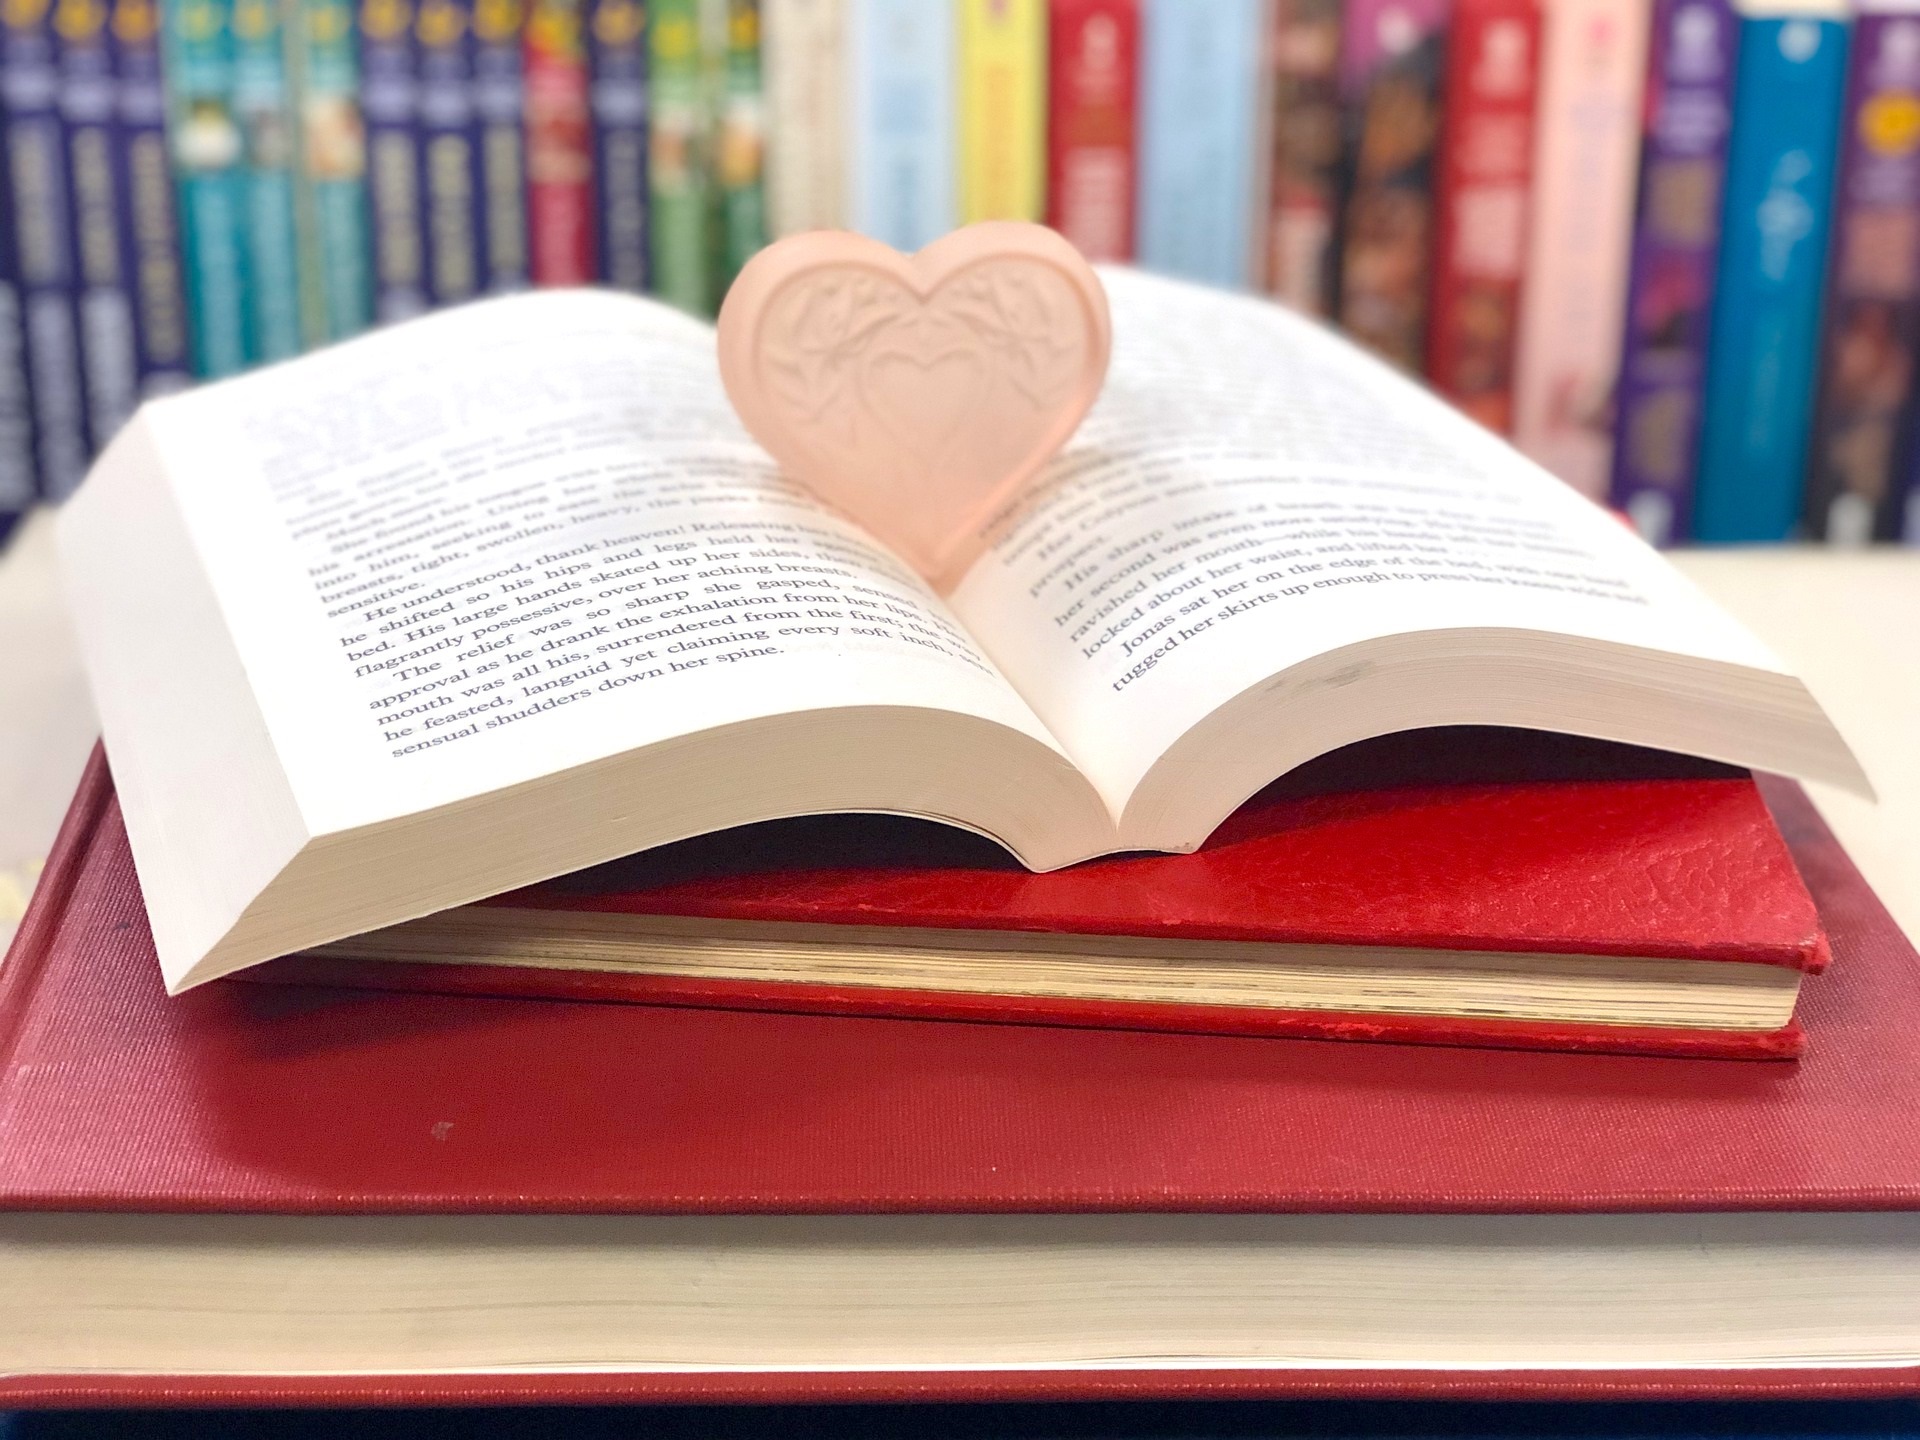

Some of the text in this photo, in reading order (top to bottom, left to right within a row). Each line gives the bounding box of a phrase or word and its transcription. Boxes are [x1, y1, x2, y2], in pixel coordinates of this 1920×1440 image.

[315, 573, 357, 590] into
[431, 521, 512, 550] seeking
[523, 511, 545, 521] to
[321, 575, 403, 603] breasts,
[411, 552, 469, 573] tight,
[476, 524, 564, 552] swollen,
[569, 506, 640, 524] heavy,
[646, 498, 682, 509] the
[328, 583, 425, 617] sensitive.
[340, 534, 800, 647] he shifted so his hips and legs held her
[364, 607, 397, 621] He
[402, 563, 531, 608] understood,
[535, 544, 599, 565] thank
[602, 525, 686, 548] heaven!
[690, 521, 796, 532] Releasing
[1054, 599, 1084, 627] her
[1090, 552, 1157, 597] second
[1161, 537, 1202, 554] was
[1206, 523, 1257, 540] even
[1064, 565, 1099, 590] His
[1106, 530, 1164, 561] sharp
[1070, 580, 1148, 642] ravished
[1151, 561, 1186, 582] her
[1082, 609, 1144, 659] locked
[1148, 577, 1204, 609] about
[1207, 563, 1242, 579] her
[1248, 549, 1312, 564] waist,
[1315, 541, 1354, 553] and
[347, 641, 395, 661] bed.
[404, 625, 445, 642] His
[452, 604, 508, 626] large
[515, 582, 582, 605] hands
[589, 561, 661, 584] skated
[668, 557, 696, 566] up
[704, 553, 739, 561] her
[749, 548, 810, 559] sides,
[354, 563, 857, 677] flagrantly possessive, over her aching breasts.
[370, 670, 470, 709] approval
[477, 662, 500, 673] as
[505, 650, 533, 663] he
[541, 626, 610, 651] drank
[616, 616, 652, 629] the
[660, 597, 778, 618] exhalation
[784, 593, 839, 602] from
[843, 595, 878, 608] her
[884, 603, 927, 623] lips.
[393, 663, 441, 681] The
[456, 634, 515, 662] relief
[529, 620, 572, 635] was
[586, 609, 610, 619] so
[625, 591, 689, 609] sharp
[704, 584, 741, 593] she
[757, 579, 840, 589] gasped,
[852, 586, 919, 610] sensed
[1113, 638, 1179, 691] tugged
[1178, 618, 1213, 640] her
[1218, 593, 1278, 619] skirts
[1280, 585, 1309, 595] up
[1313, 572, 1390, 588] enough
[1121, 616, 1175, 657] Jonas
[1180, 597, 1209, 615] sat
[1212, 581, 1247, 598] her
[1256, 572, 1284, 583] on
[1288, 564, 1323, 574] the
[1328, 556, 1378, 568] edge
[1383, 555, 1404, 566] of
[1408, 556, 1443, 566] the
[377, 696, 454, 725] mouth
[461, 679, 505, 696] was
[512, 665, 541, 681] all
[546, 654, 589, 669] his,
[596, 615, 737, 653] surrendered
[743, 612, 801, 622] from
[807, 609, 843, 617] the
[850, 610, 904, 629] first;
[908, 623, 941, 639] the
[384, 728, 413, 741] he
[424, 696, 513, 730] feasted,
[522, 661, 611, 697] languid
[620, 651, 657, 667] yet
[668, 631, 769, 653] claiming
[778, 627, 839, 635] every
[851, 628, 892, 638] soft
[901, 632, 953, 657] inch,
[392, 647, 784, 757] sensual shudders down her spine.
